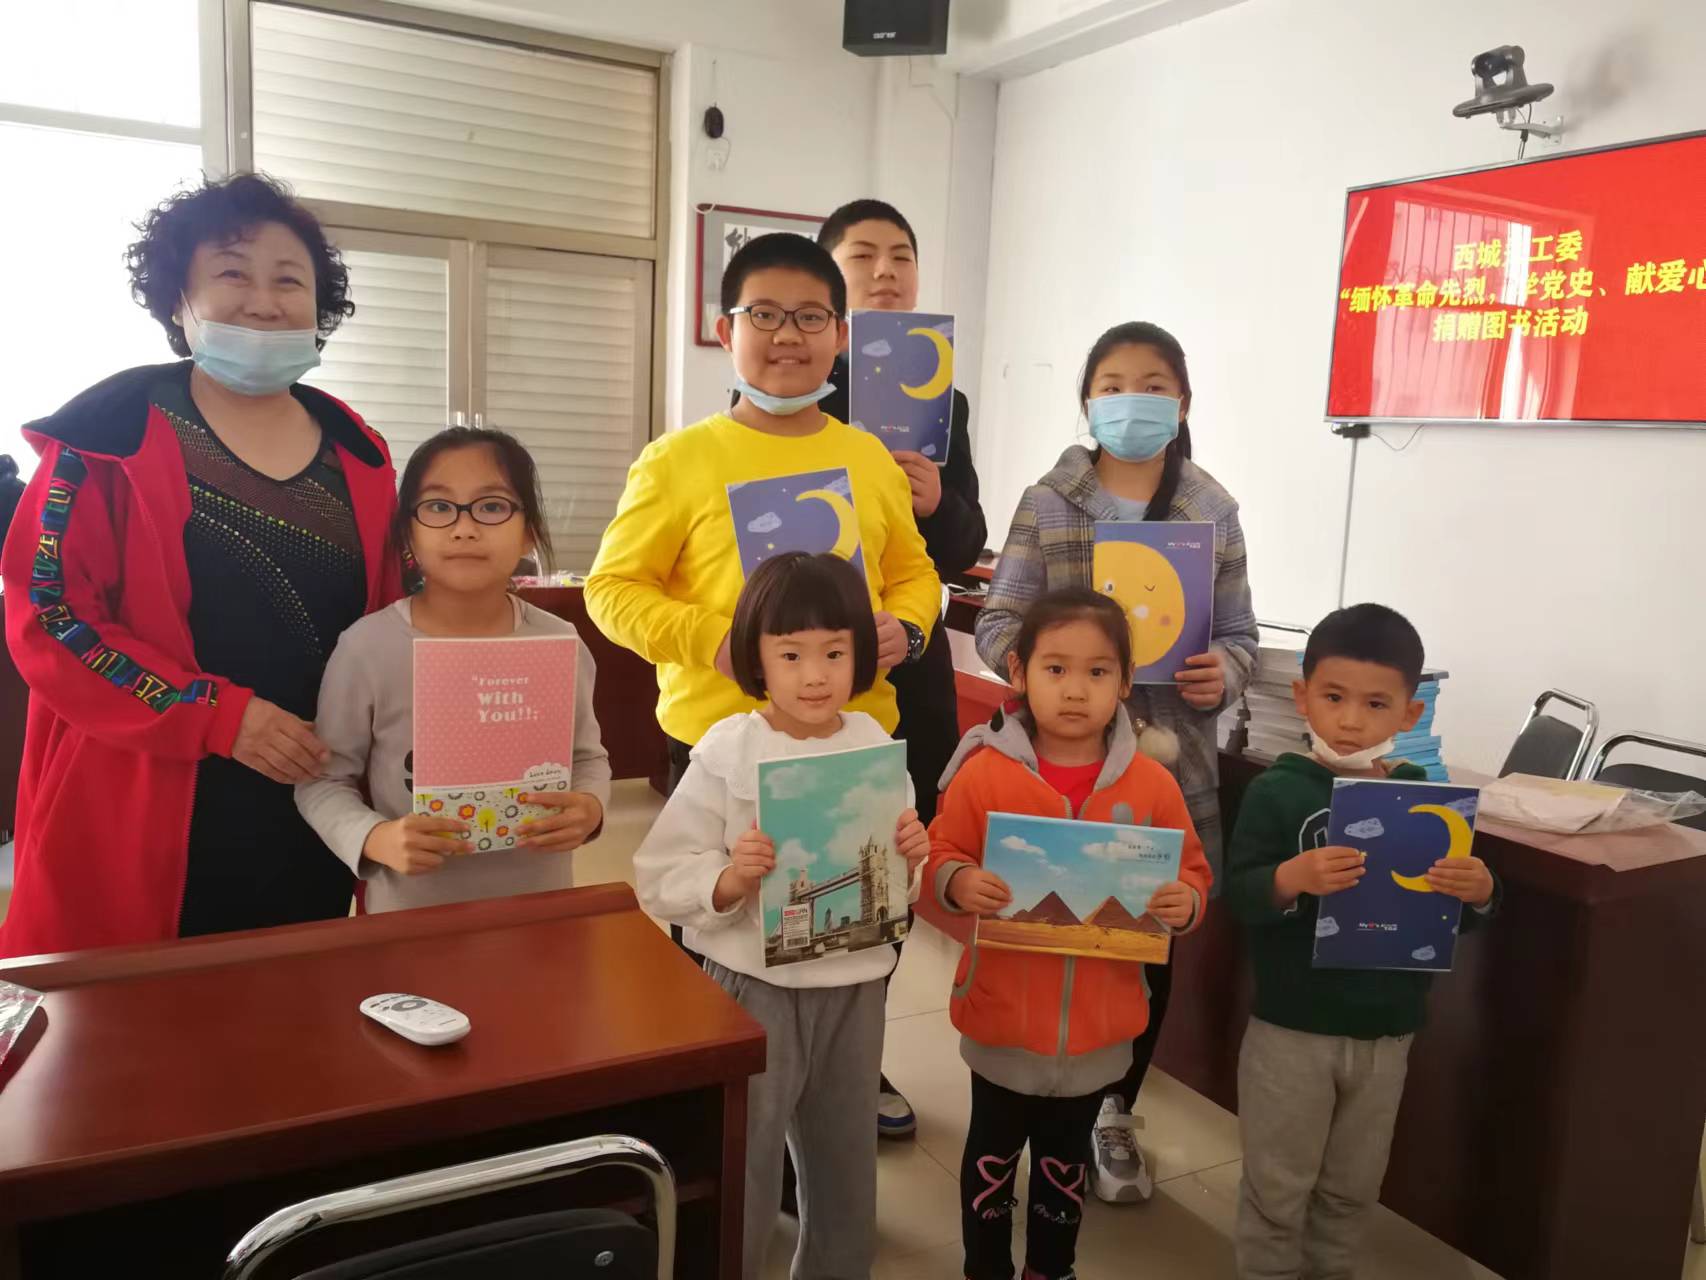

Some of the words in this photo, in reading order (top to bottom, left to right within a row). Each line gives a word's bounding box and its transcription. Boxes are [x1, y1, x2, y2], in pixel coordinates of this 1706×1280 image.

[1453, 230, 1582, 272] 西城工委
[1433, 305, 1588, 342] 捐赠图书活动
